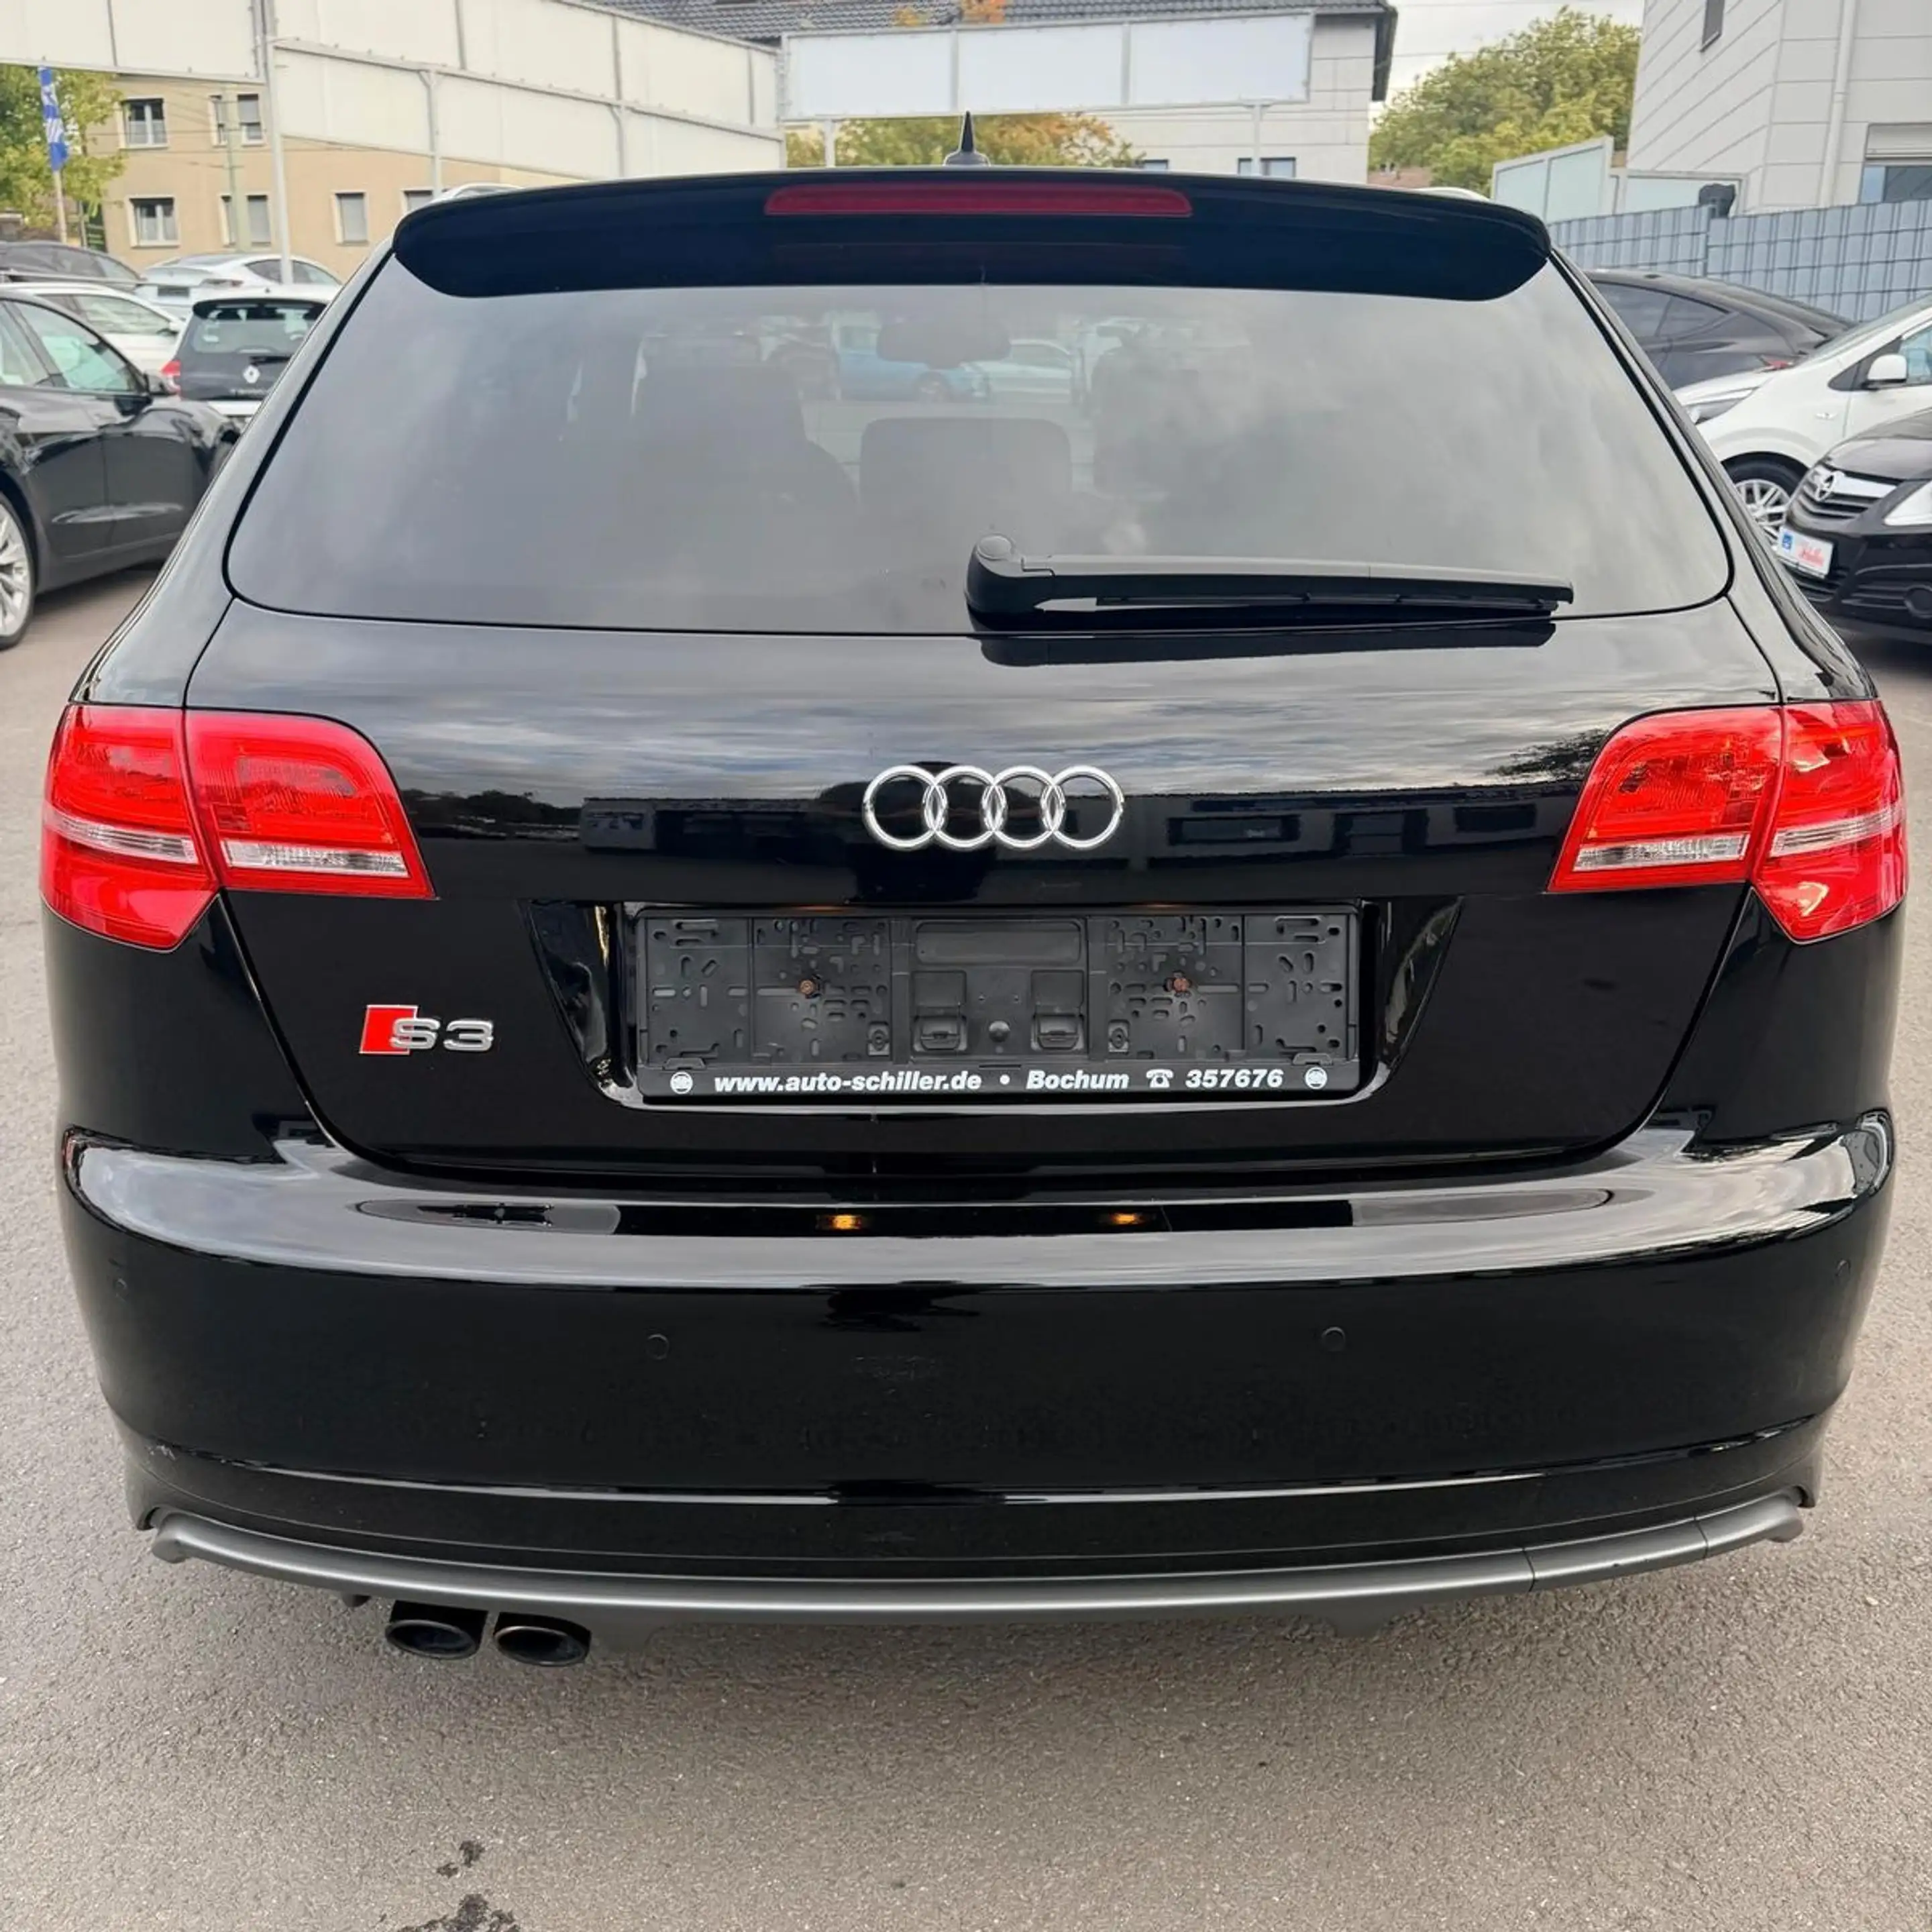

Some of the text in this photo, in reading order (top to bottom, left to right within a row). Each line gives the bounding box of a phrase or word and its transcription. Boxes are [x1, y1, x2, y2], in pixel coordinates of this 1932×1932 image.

[389, 1018, 494, 1051] S3
[714, 1069, 1285, 1093] www.auto-schiller.de Bochum 357676
